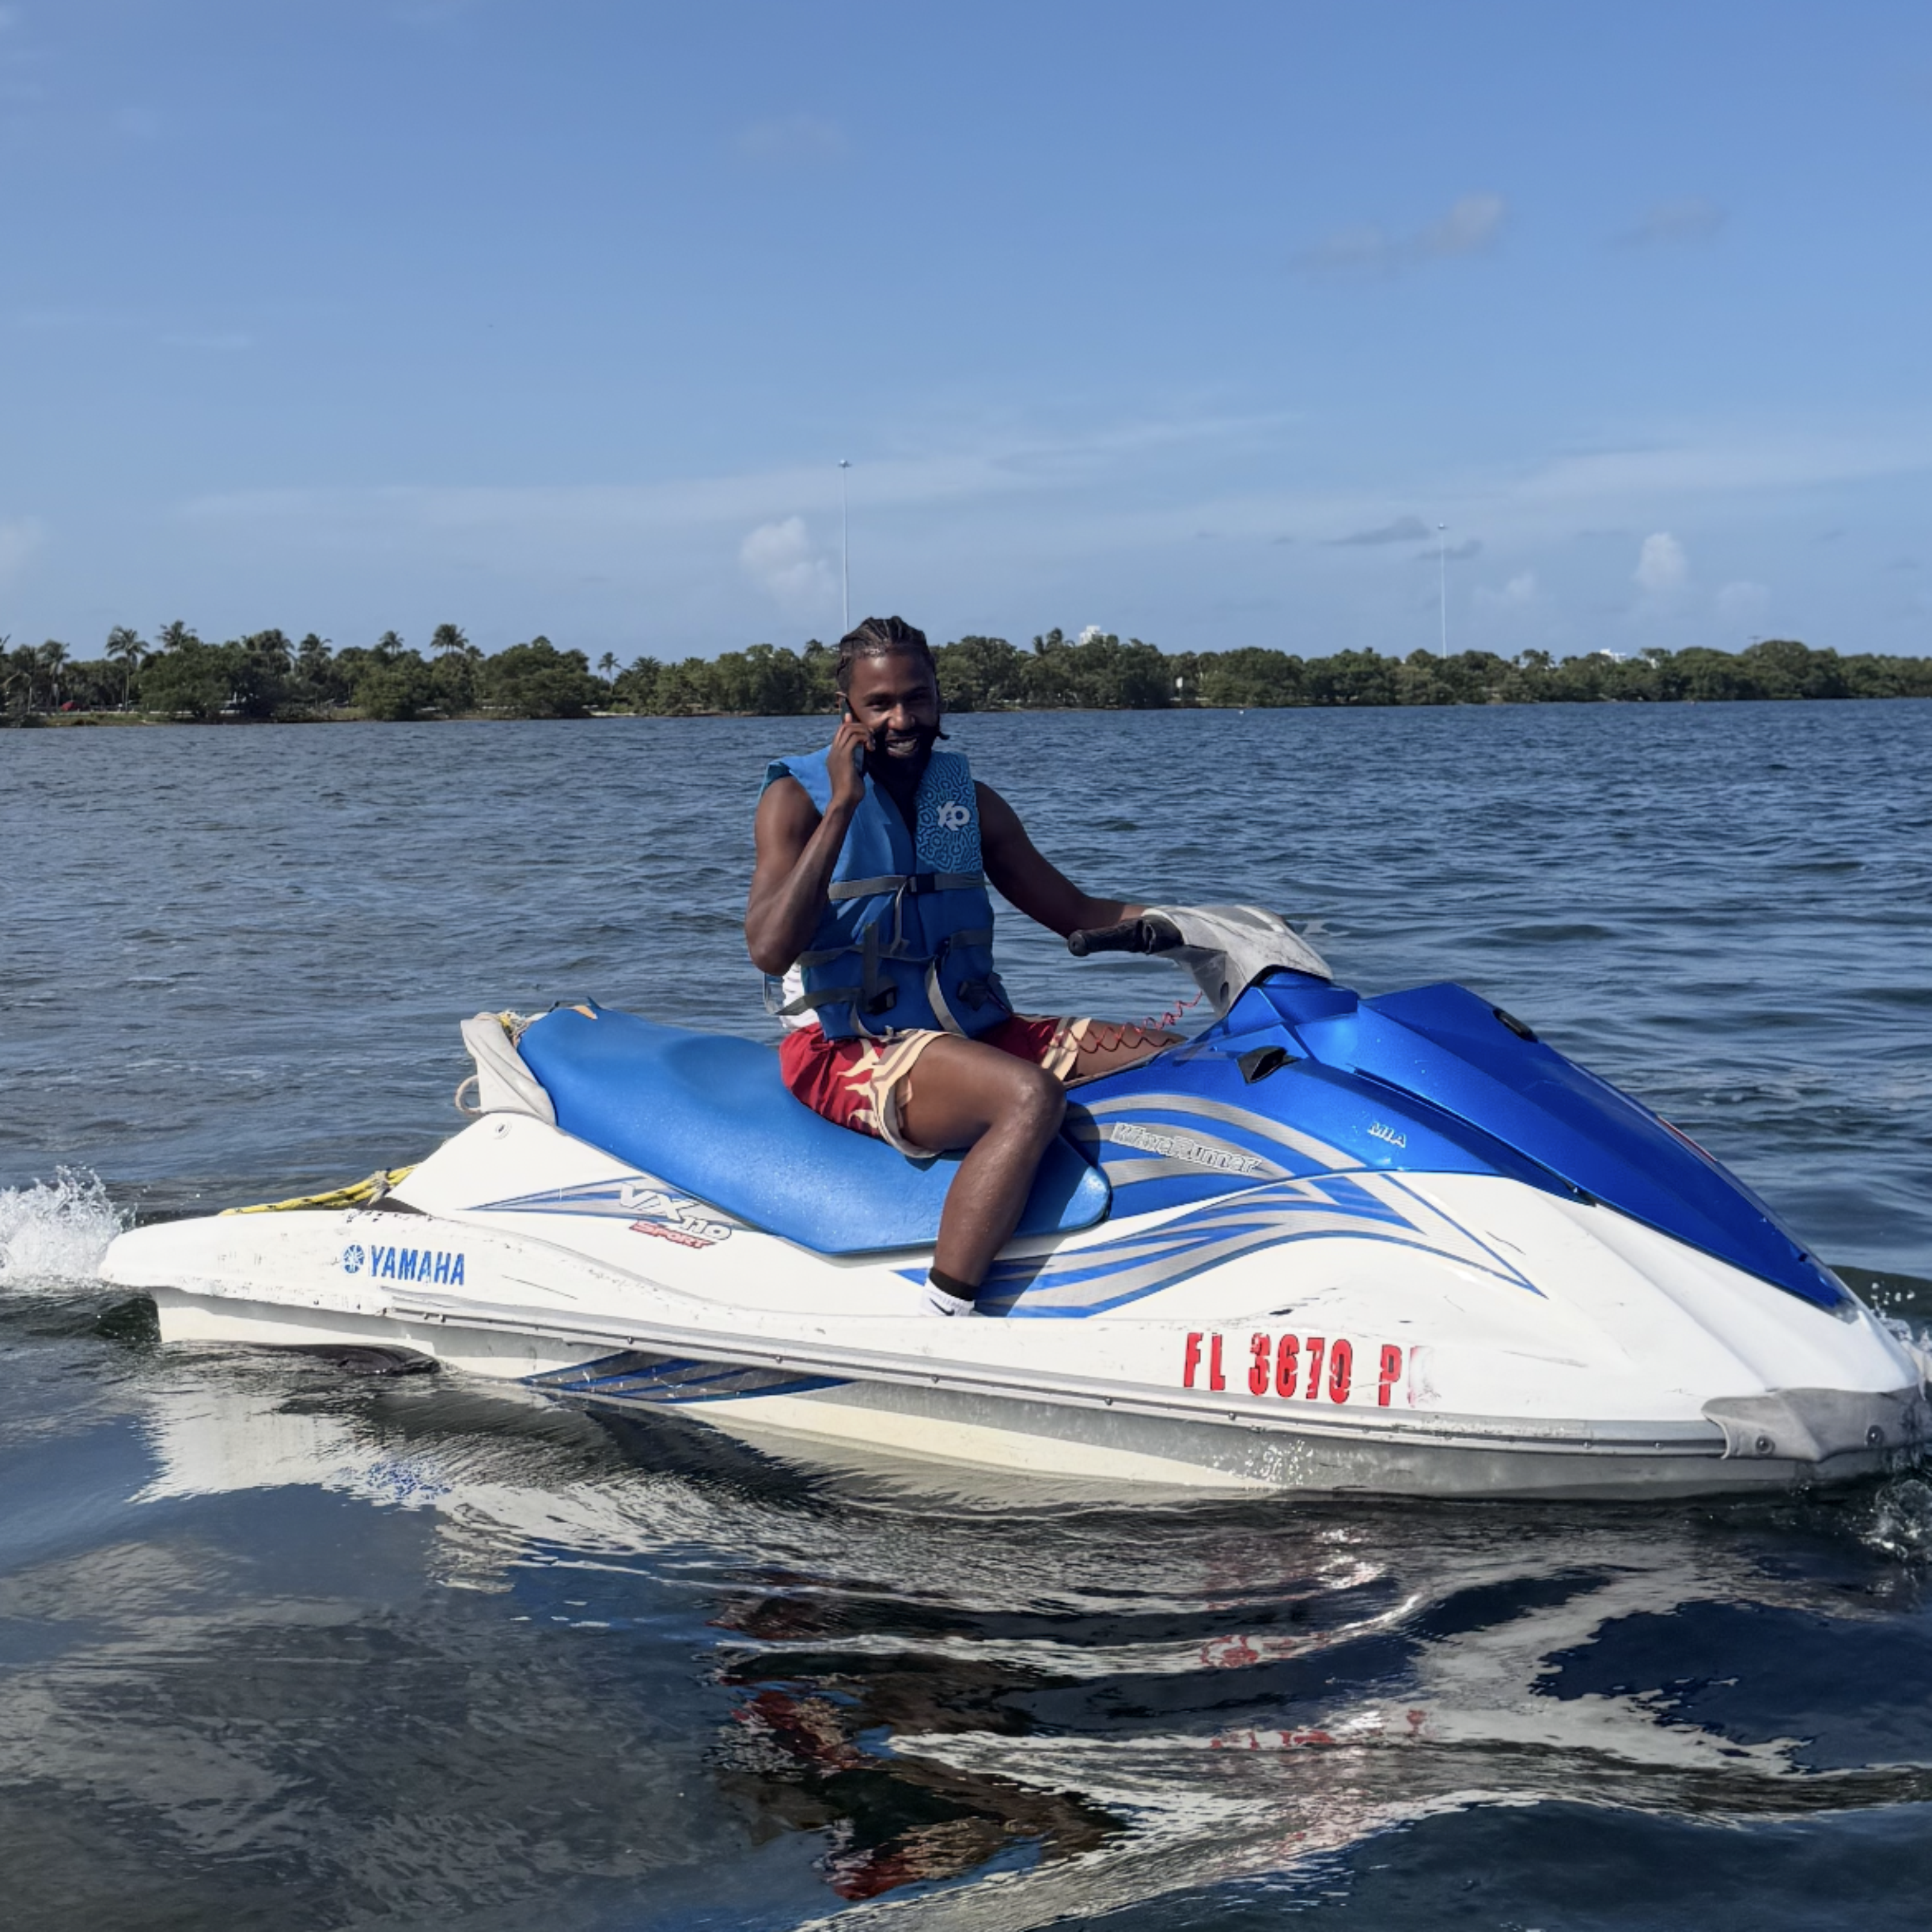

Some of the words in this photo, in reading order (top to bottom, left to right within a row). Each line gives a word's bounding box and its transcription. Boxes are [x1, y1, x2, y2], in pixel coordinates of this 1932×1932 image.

[1110, 1122, 1262, 1175] WaveRunner
[371, 1245, 465, 1285] YAMAHA
[1184, 1332, 1226, 1391] FL
[1248, 1332, 1353, 1405] 3670
